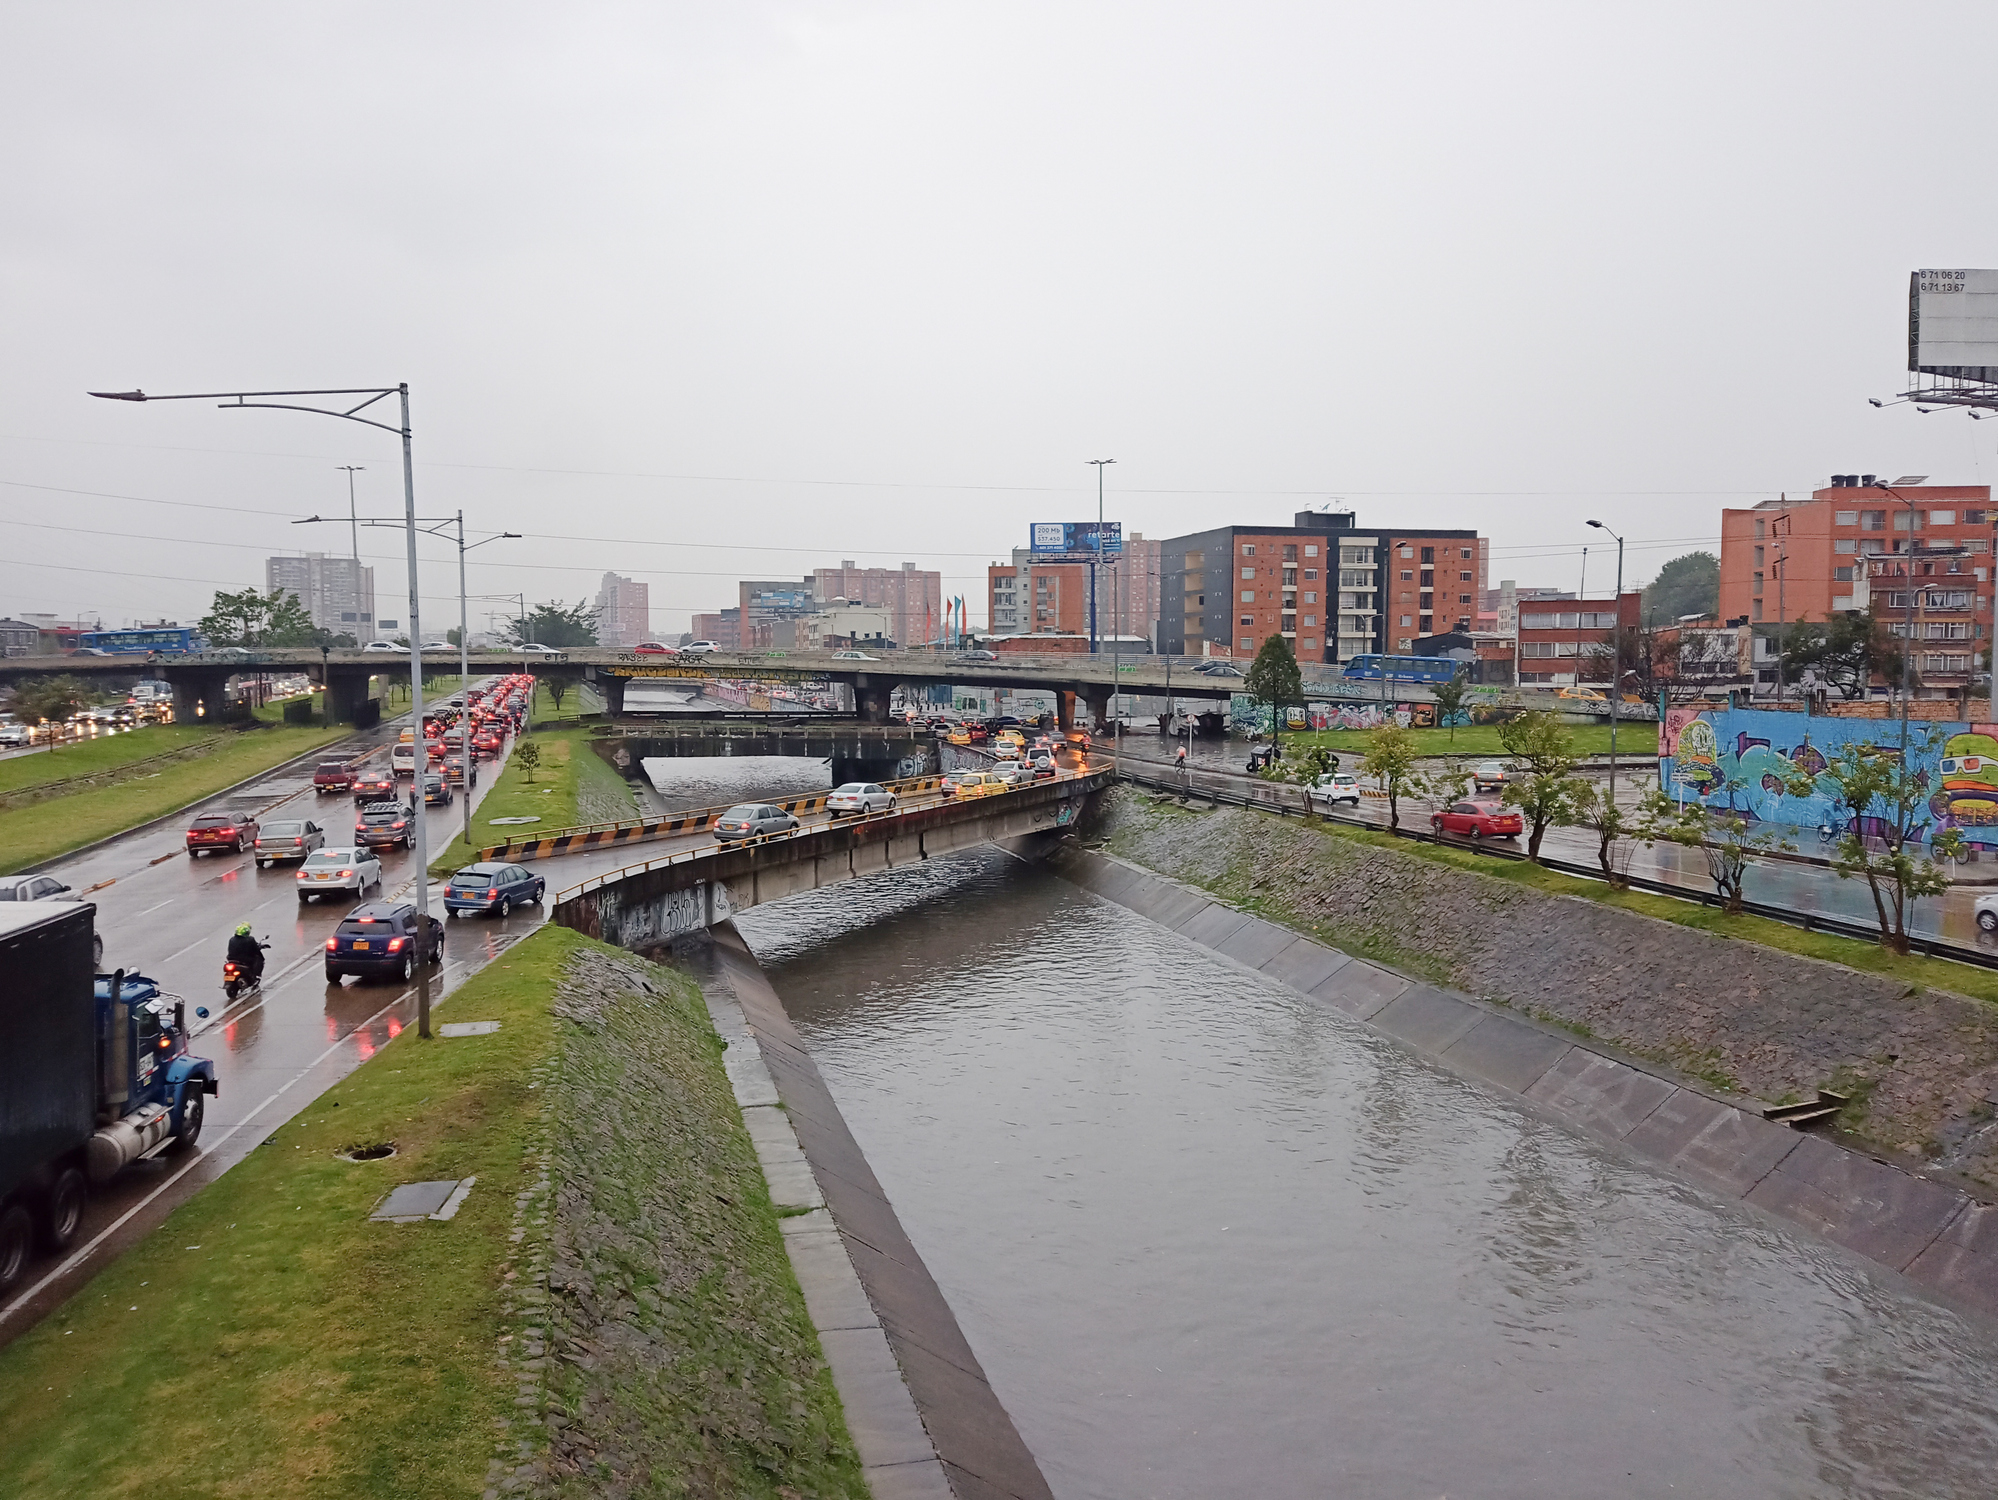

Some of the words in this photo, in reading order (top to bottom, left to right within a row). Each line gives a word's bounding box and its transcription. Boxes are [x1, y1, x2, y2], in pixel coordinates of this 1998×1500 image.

[1921, 271, 1926, 279] 6
[1929, 271, 1939, 279] 71
[1942, 271, 1952, 279] 06
[1955, 271, 1965, 279] 20
[1921, 283, 1926, 291] 6
[1929, 283, 1939, 291] 71
[1942, 283, 1952, 291] 13
[1954, 283, 1965, 291] 67
